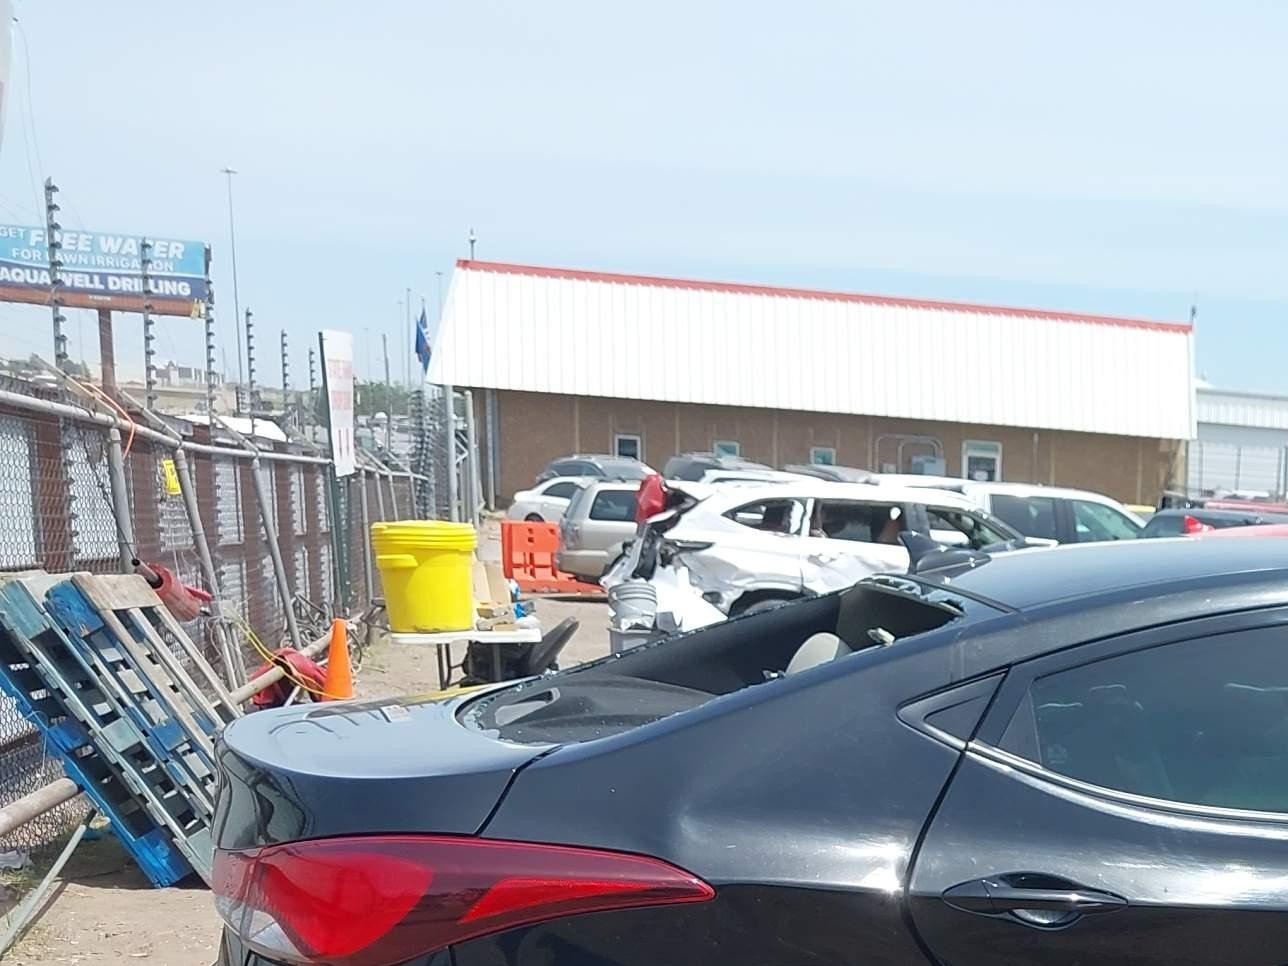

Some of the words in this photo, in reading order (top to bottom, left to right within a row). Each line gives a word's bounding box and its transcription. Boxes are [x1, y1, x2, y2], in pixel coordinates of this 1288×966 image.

[0, 226, 25, 240] GET
[12, 247, 42, 261] FOR
[92, 254, 174, 273] IRRIGAON
[0, 266, 52, 285] AQUA
[56, 271, 105, 290] WELL
